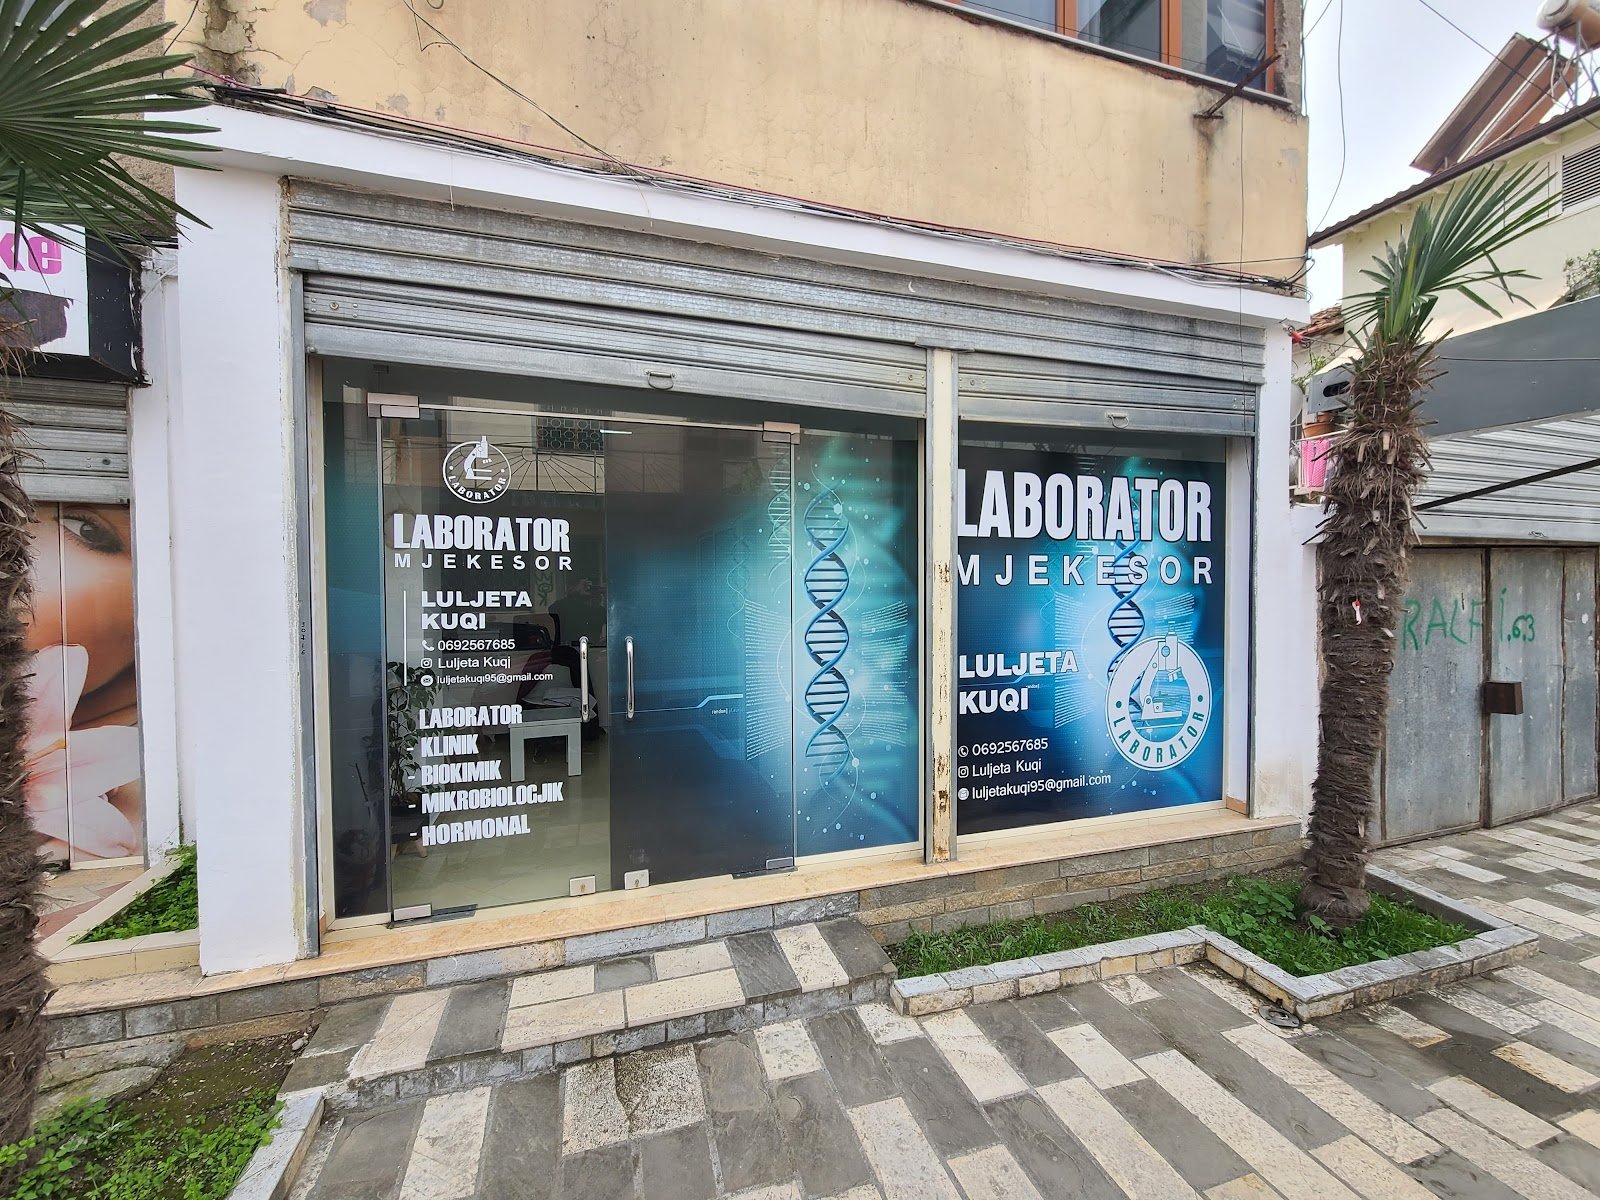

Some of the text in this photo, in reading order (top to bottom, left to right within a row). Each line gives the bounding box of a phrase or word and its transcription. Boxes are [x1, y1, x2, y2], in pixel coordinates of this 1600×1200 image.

[447, 475, 507, 501] LABORATOR
[957, 469, 1212, 542] LABORATOR
[393, 513, 570, 552] LABORATOR
[394, 554, 572, 571] MJEKESOR
[957, 555, 1213, 586] MJEKESOR
[421, 591, 533, 608] LULJETA
[421, 612, 486, 631] KUQI
[437, 639, 516, 651] 0692567685
[437, 658, 480, 670] Luljeta
[959, 650, 1079, 679] LULJETA
[959, 688, 1030, 715] KUQI
[419, 704, 523, 730] LABORATOR
[421, 734, 479, 757] KLINIK
[972, 738, 1049, 756] 0692567685
[1112, 711, 1205, 763] LABORATOR
[421, 760, 502, 786] BIOKIMIK
[972, 758, 1042, 779] Luljeta Kuqi
[972, 774, 1111, 800] luljetakuqi95@gmail.com
[422, 814, 531, 847] HORMONAL
